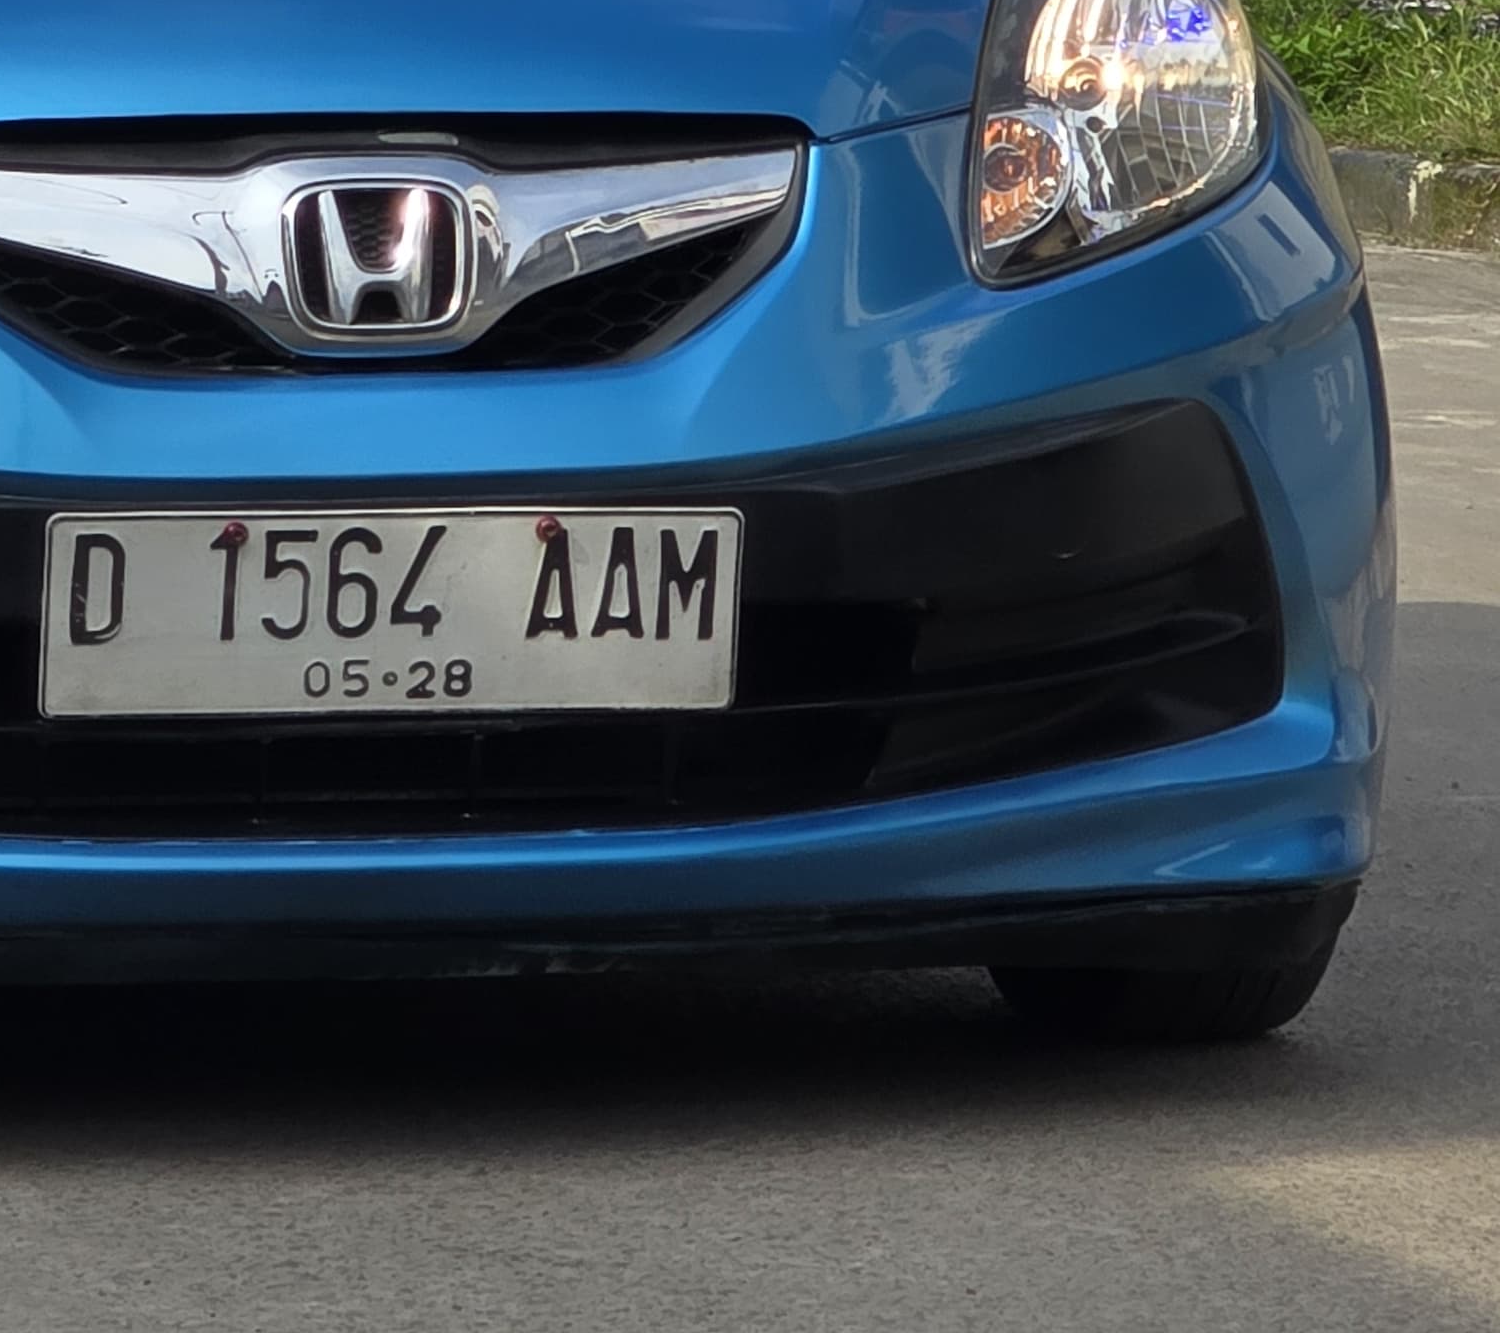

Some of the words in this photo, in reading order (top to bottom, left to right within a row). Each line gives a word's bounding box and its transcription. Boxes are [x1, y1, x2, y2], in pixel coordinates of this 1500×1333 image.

[70, 533, 126, 647] D
[209, 524, 448, 641] 1564
[525, 526, 719, 641] AAM
